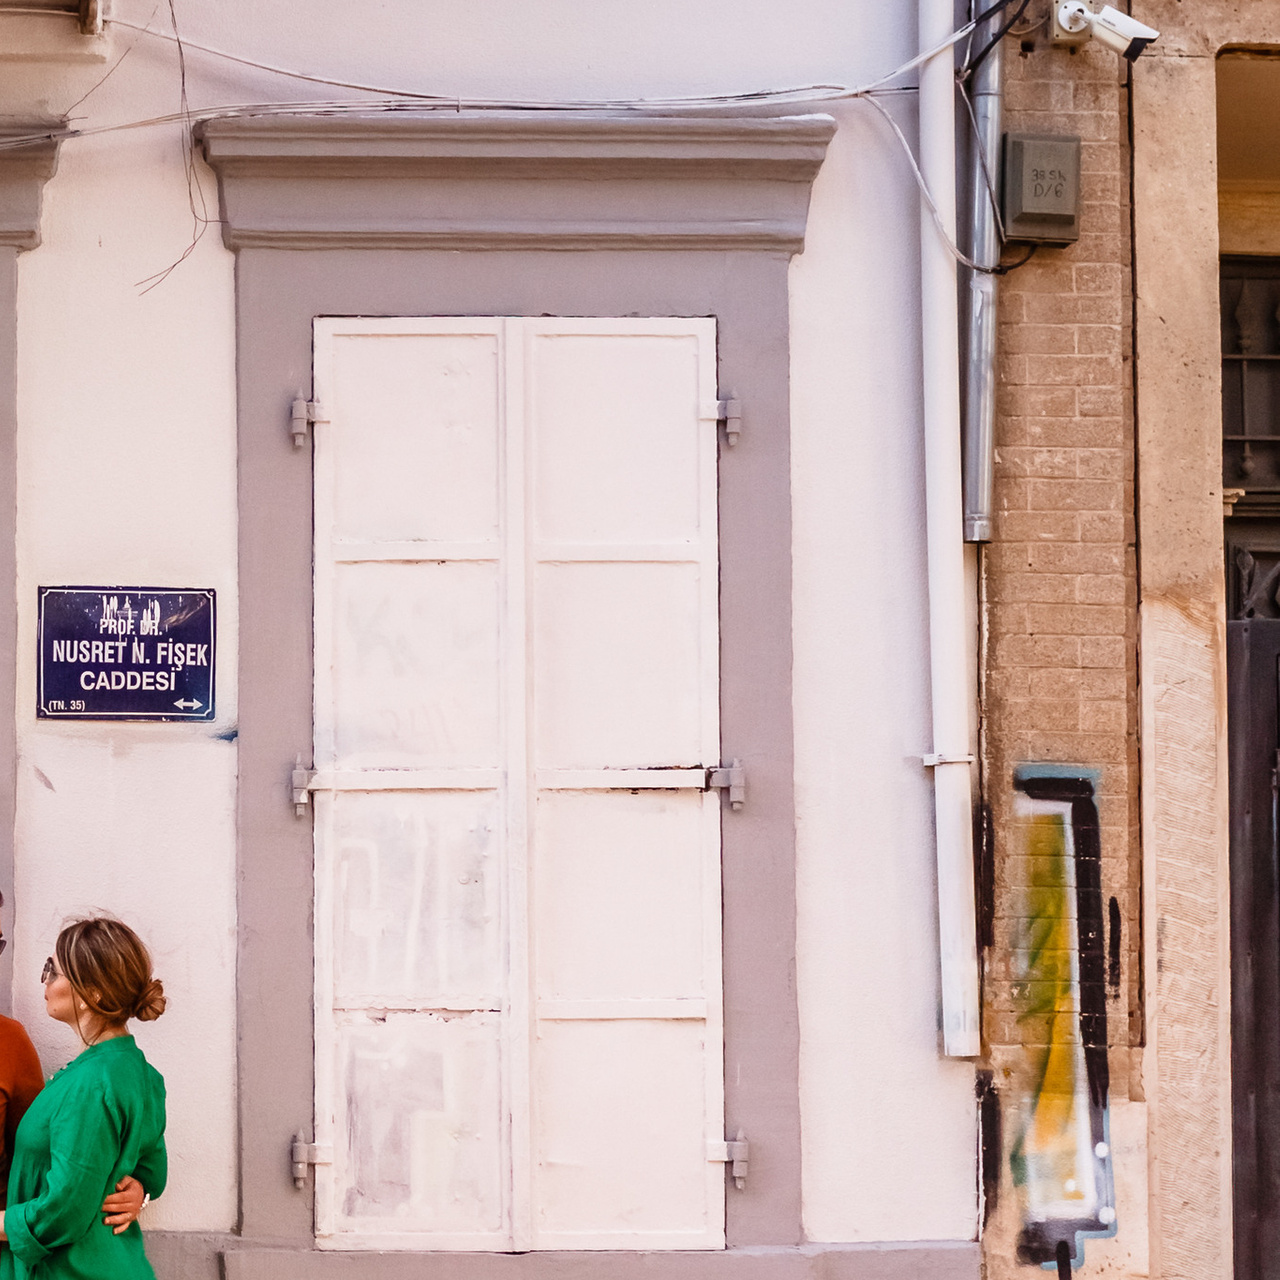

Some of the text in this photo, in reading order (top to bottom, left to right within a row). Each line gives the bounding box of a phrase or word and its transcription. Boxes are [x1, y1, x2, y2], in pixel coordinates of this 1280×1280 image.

[99, 618, 163, 636] PROF. DR.
[53, 638, 208, 671] NUSRET N. FİŞEK
[80, 667, 176, 691] CADDESİ
[48, 699, 86, 711] (TN. 35)
